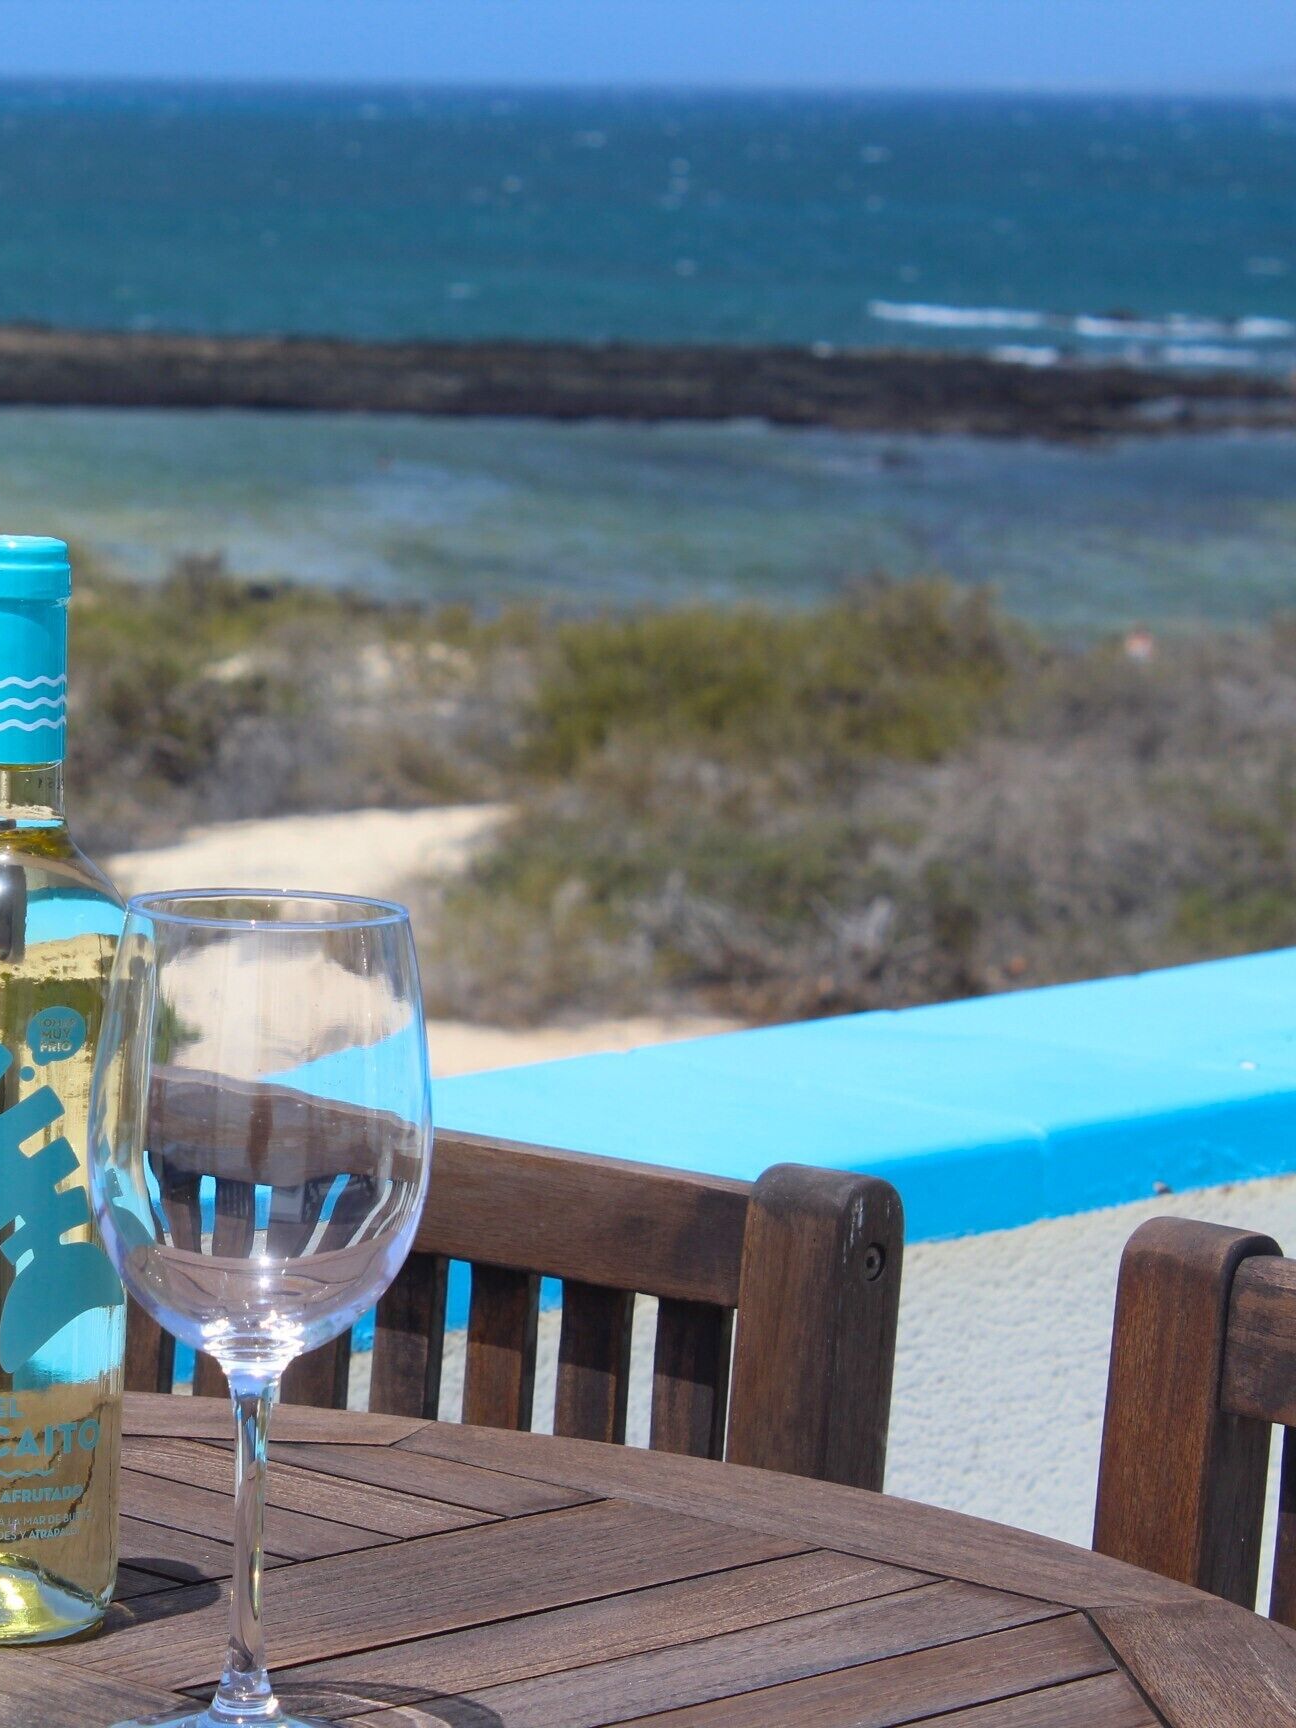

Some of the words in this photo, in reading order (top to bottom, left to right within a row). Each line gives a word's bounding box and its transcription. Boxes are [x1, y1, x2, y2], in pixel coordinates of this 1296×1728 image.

[0, 1485, 84, 1504] AFRUTADO
[23, 1515, 46, 1526] MAR
[48, 1514, 62, 1524] DE
[19, 1530, 27, 1539] Y
